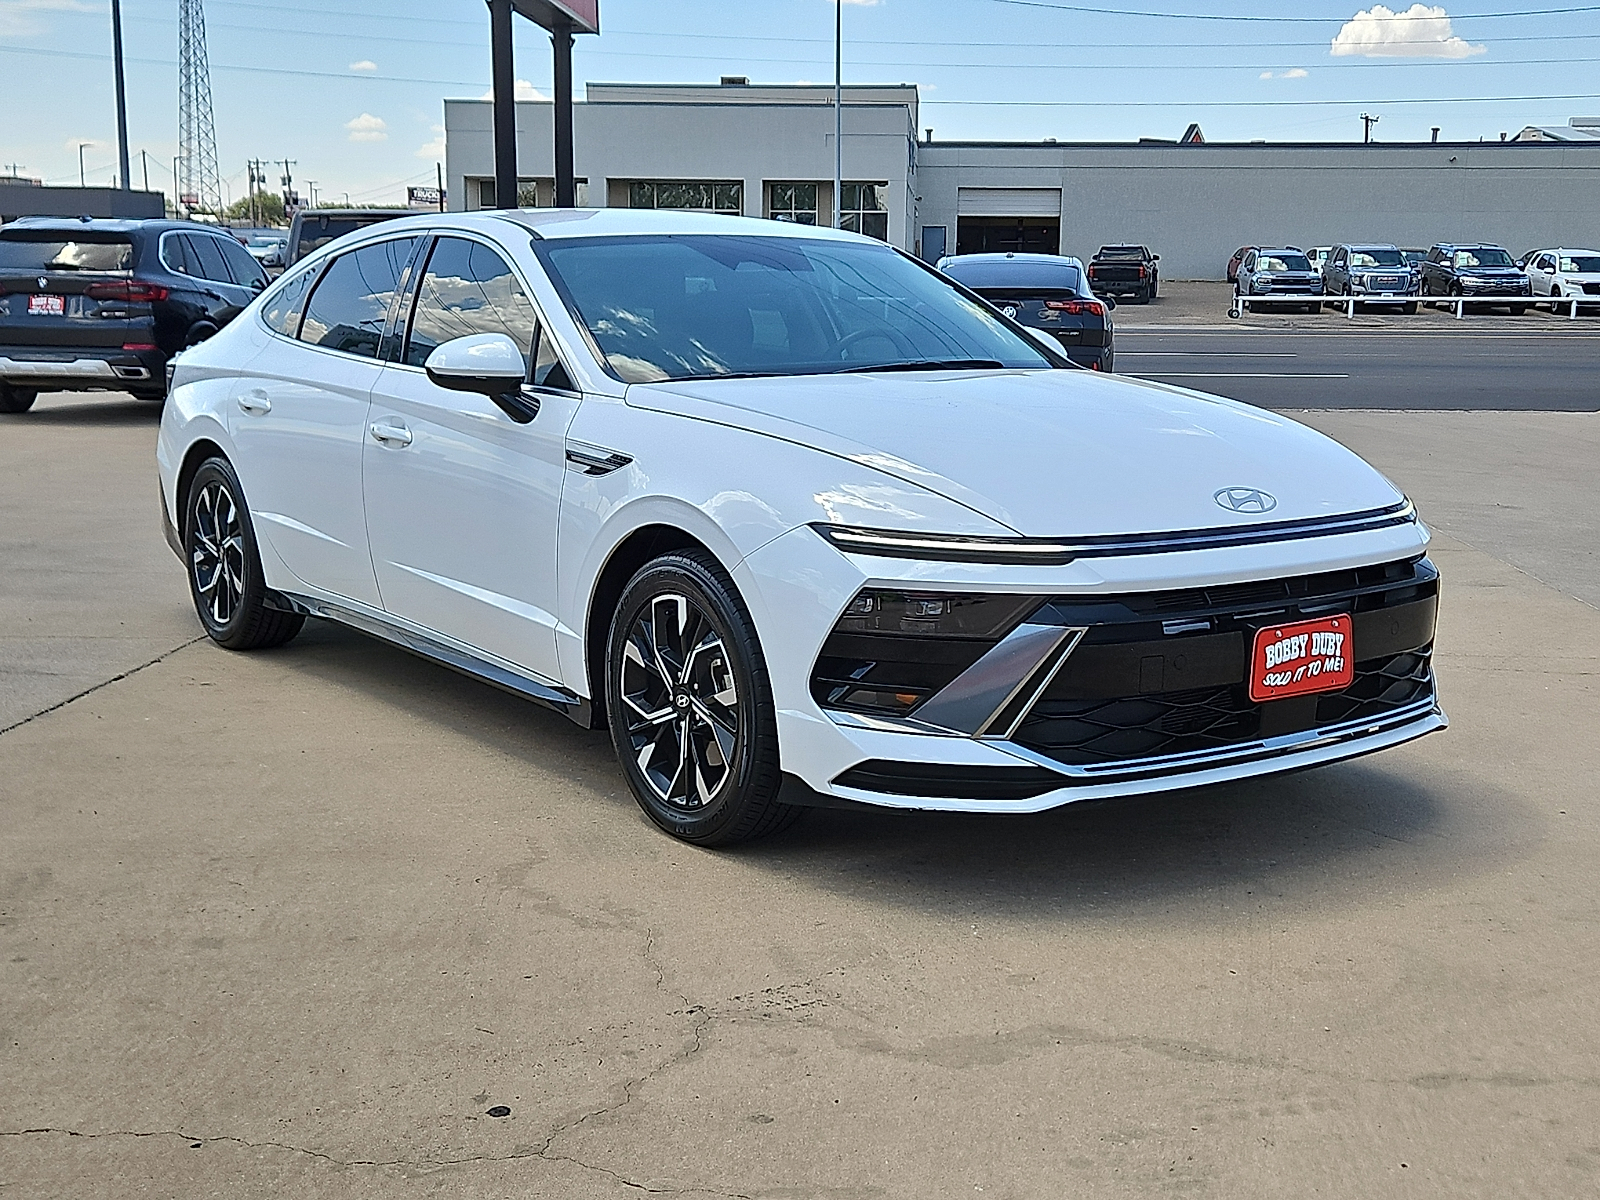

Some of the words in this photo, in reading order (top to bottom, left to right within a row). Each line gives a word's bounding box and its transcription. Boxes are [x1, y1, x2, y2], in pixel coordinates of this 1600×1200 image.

[1265, 634, 1308, 669] BOBBY
[1311, 632, 1344, 656] DUBY
[1262, 671, 1292, 686] SOLD
[1293, 666, 1307, 683] IT
[1307, 660, 1322, 678] TO
[1323, 657, 1344, 673] ME!
